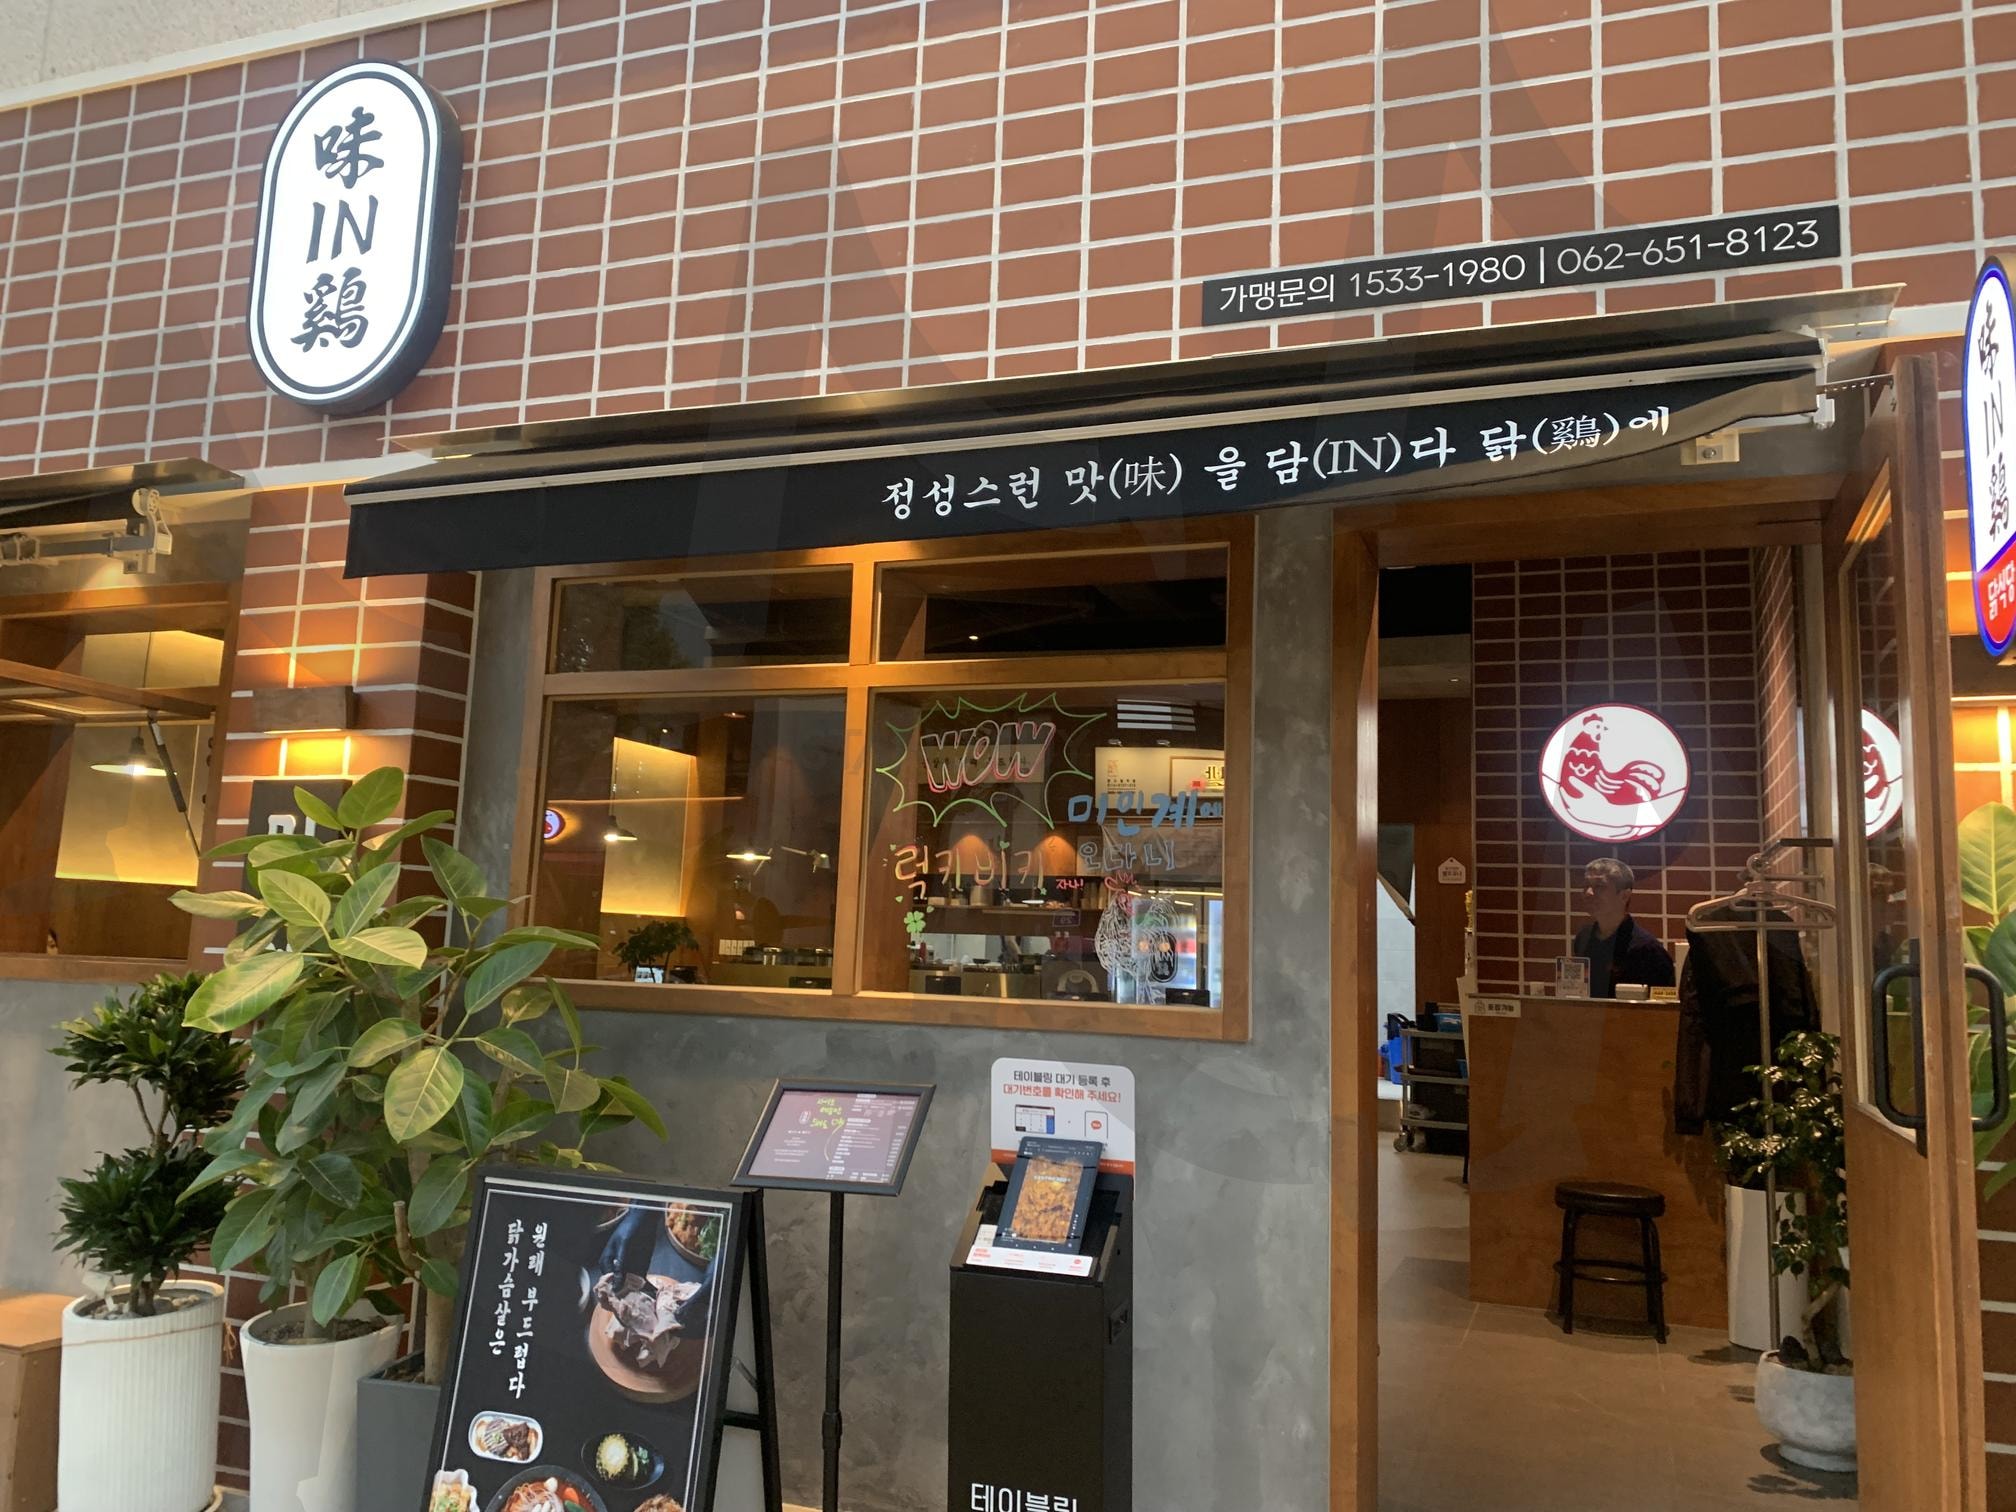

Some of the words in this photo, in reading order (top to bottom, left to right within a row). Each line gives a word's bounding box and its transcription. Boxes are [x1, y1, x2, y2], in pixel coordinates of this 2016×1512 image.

[1219, 273, 1335, 313] 가맹문의
[1349, 253, 1526, 298] 1533-1980
[1556, 218, 1820, 275] 062-651-8123
[881, 466, 1040, 520] 정성스런
[920, 719, 1057, 793] WOW
[894, 843, 1045, 901] 럭키비키
[1079, 839, 1176, 872] 온다니
[1003, 1083, 1052, 1098] 대기번호를
[1054, 1086, 1085, 1101] 확인해
[1087, 1089, 1121, 1104] 주세요!
[1013, 1070, 1053, 1084] 테이블링
[1055, 1072, 1076, 1086] 대기
[1077, 1074, 1099, 1087] 등록
[1101, 1076, 1112, 1088] 후
[527, 1221, 548, 1277] 원래
[488, 1218, 525, 1356] 닭가슴살은
[508, 1286, 539, 1400] 부드럽다
